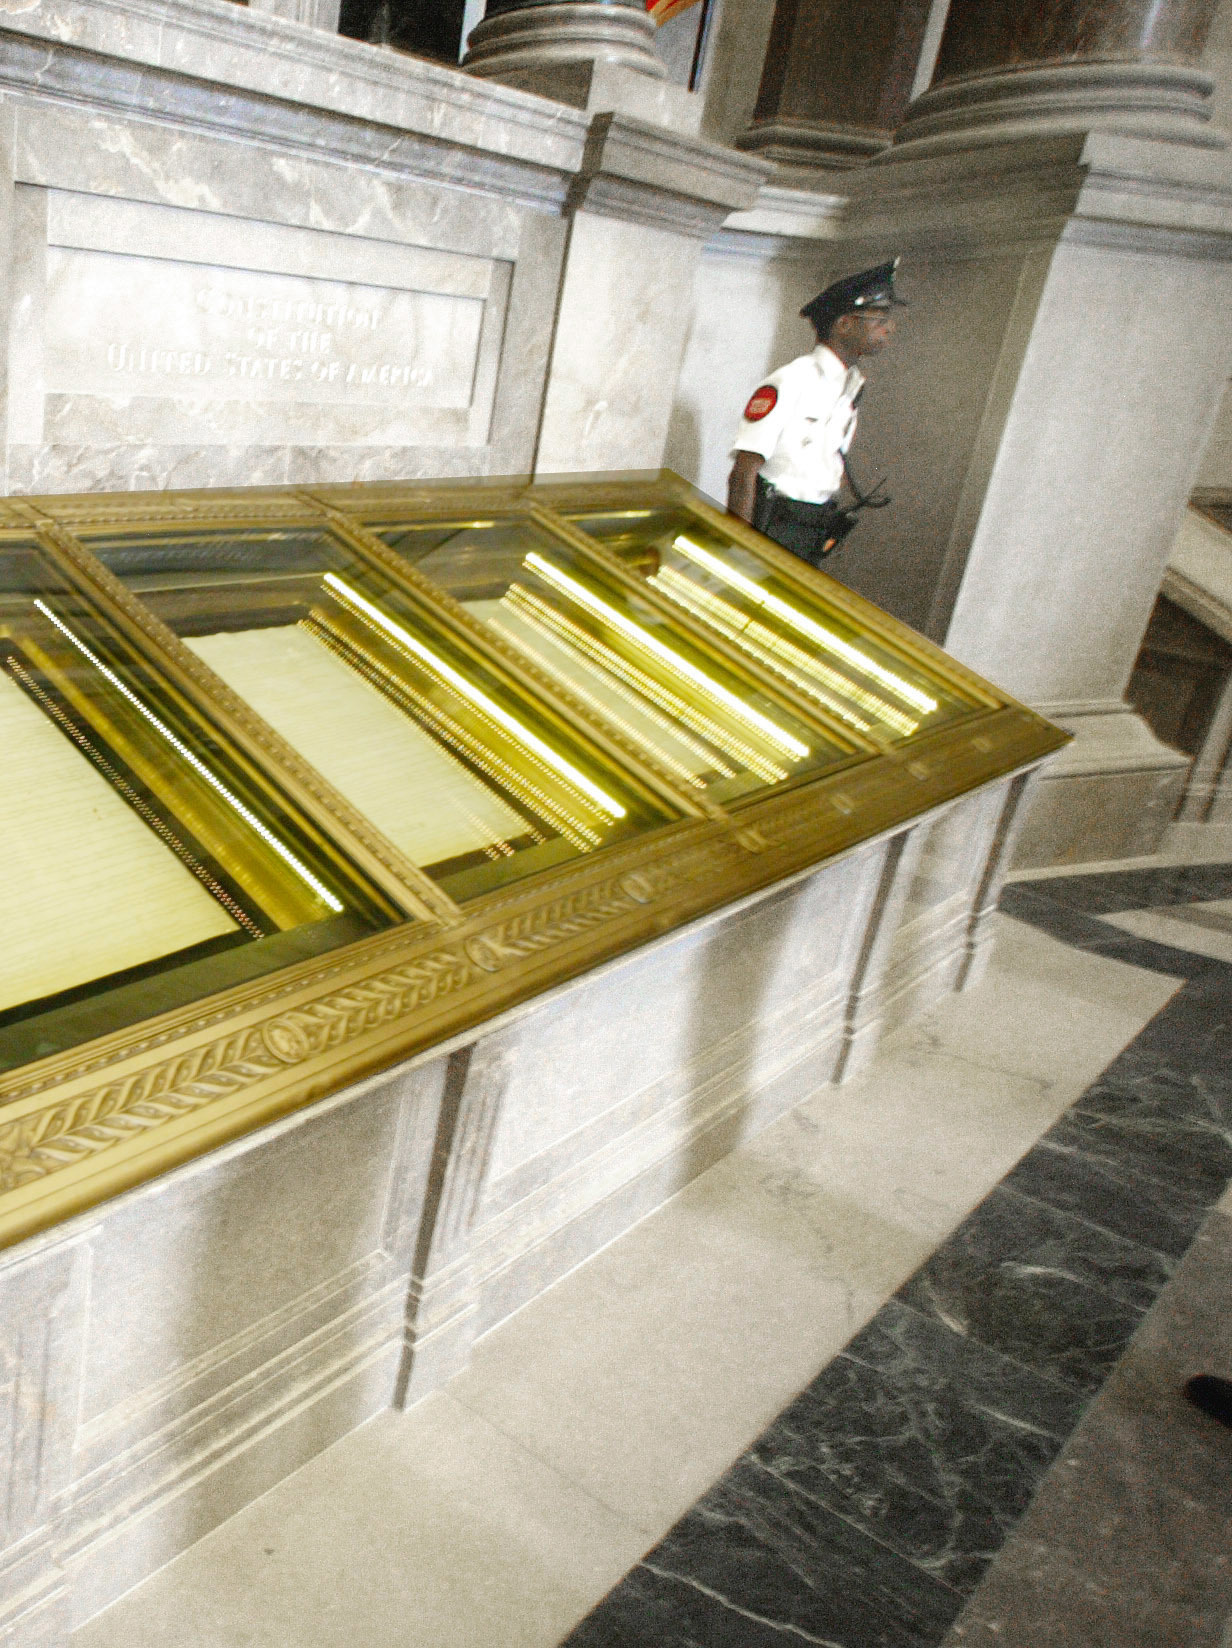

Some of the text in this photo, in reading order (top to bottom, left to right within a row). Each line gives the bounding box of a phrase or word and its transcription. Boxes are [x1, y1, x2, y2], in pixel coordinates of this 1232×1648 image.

[247, 327, 334, 354] OF THE
[106, 343, 433, 388] UNITED STATES OF AMERICA
